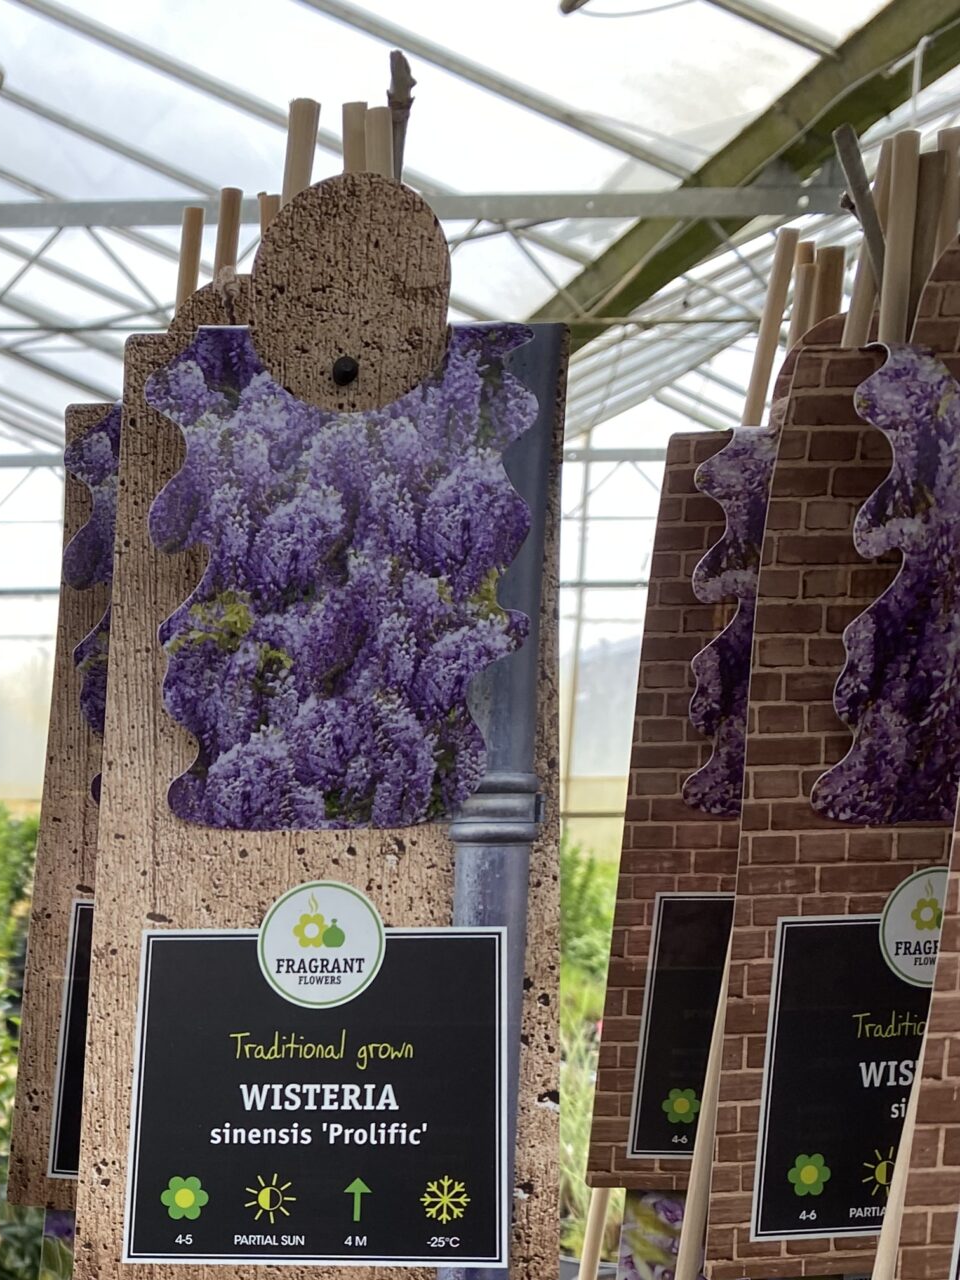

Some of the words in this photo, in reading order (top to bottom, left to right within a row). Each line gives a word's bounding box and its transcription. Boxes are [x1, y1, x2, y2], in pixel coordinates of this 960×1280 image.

[275, 957, 365, 974] FRAGRANT
[298, 975, 342, 986] FLOWERS
[229, 1028, 346, 1060] Traditional
[356, 1042, 414, 1070] grown
[858, 1059, 920, 1088] WIS
[239, 1083, 400, 1111] WISTERIA
[210, 1122, 312, 1145] sinensis
[322, 1122, 428, 1146] 'Prolific'
[671, 1134, 689, 1144] 4-6
[798, 1209, 817, 1221] 4-6
[174, 1233, 193, 1245] 4-5
[233, 1234, 279, 1246] PARTIAL
[280, 1234, 305, 1246] SUN
[343, 1235, 352, 1246] 4
[354, 1235, 367, 1247] M
